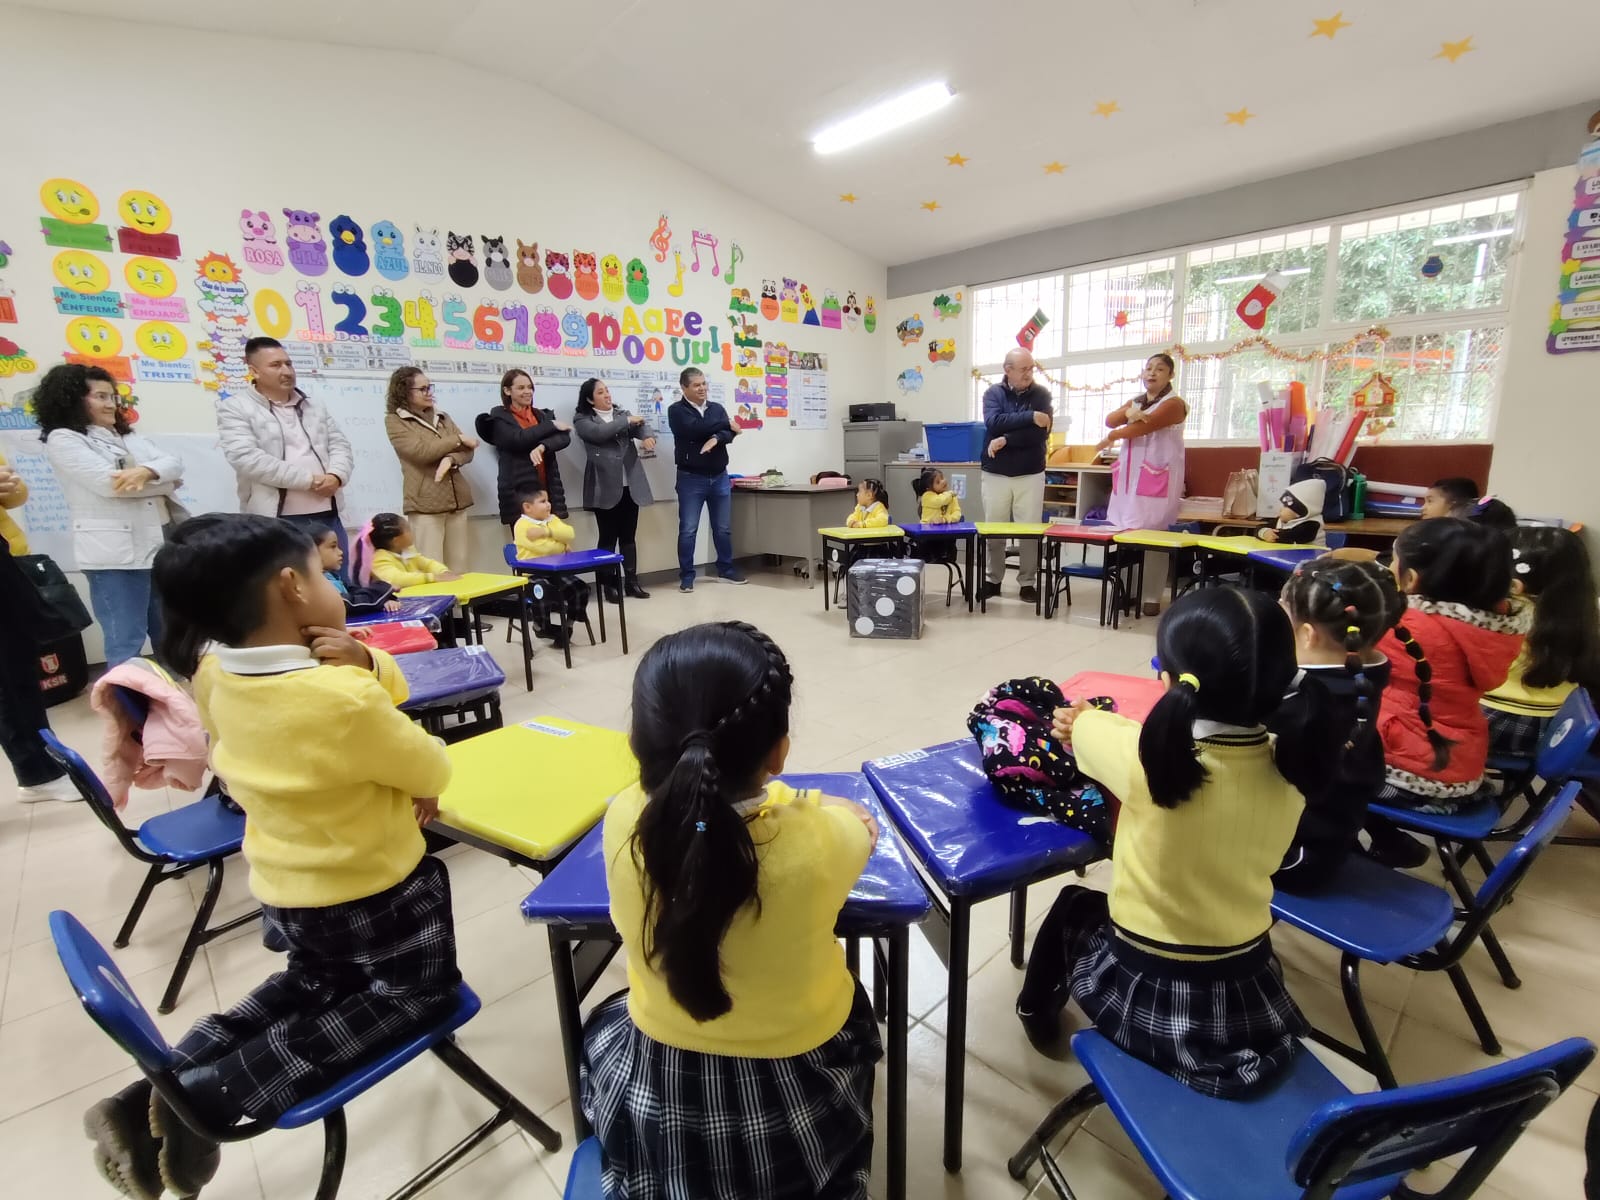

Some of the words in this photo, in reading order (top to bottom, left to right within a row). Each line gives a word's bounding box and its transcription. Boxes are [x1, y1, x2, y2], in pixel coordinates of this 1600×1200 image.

[244, 247, 284, 266] ROSA
[291, 250, 328, 267] LILA
[376, 255, 409, 273] AZUL
[413, 258, 443, 275] BLANCO
[60, 291, 76, 299] Me
[80, 293, 117, 303] Siento:
[62, 303, 119, 314] ENFERMO
[133, 309, 184, 319] ENOJADO
[254, 288, 292, 339] 0
[295, 290, 324, 336] 1
[331, 290, 368, 336] 2
[371, 294, 404, 338] 3
[404, 297, 436, 342] 4
[442, 300, 473, 343] 5
[473, 303, 503, 343] 6
[534, 311, 562, 350] 8
[562, 312, 589, 349] 9
[586, 311, 621, 350] 10
[297, 329, 335, 342] Uno
[334, 330, 369, 343] Dos
[371, 333, 404, 344] Tres
[475, 340, 504, 351] Seis
[536, 345, 561, 355] Ocho
[593, 347, 617, 356] Diez
[159, 361, 191, 369] Siento:
[141, 370, 192, 379] TRISTE
